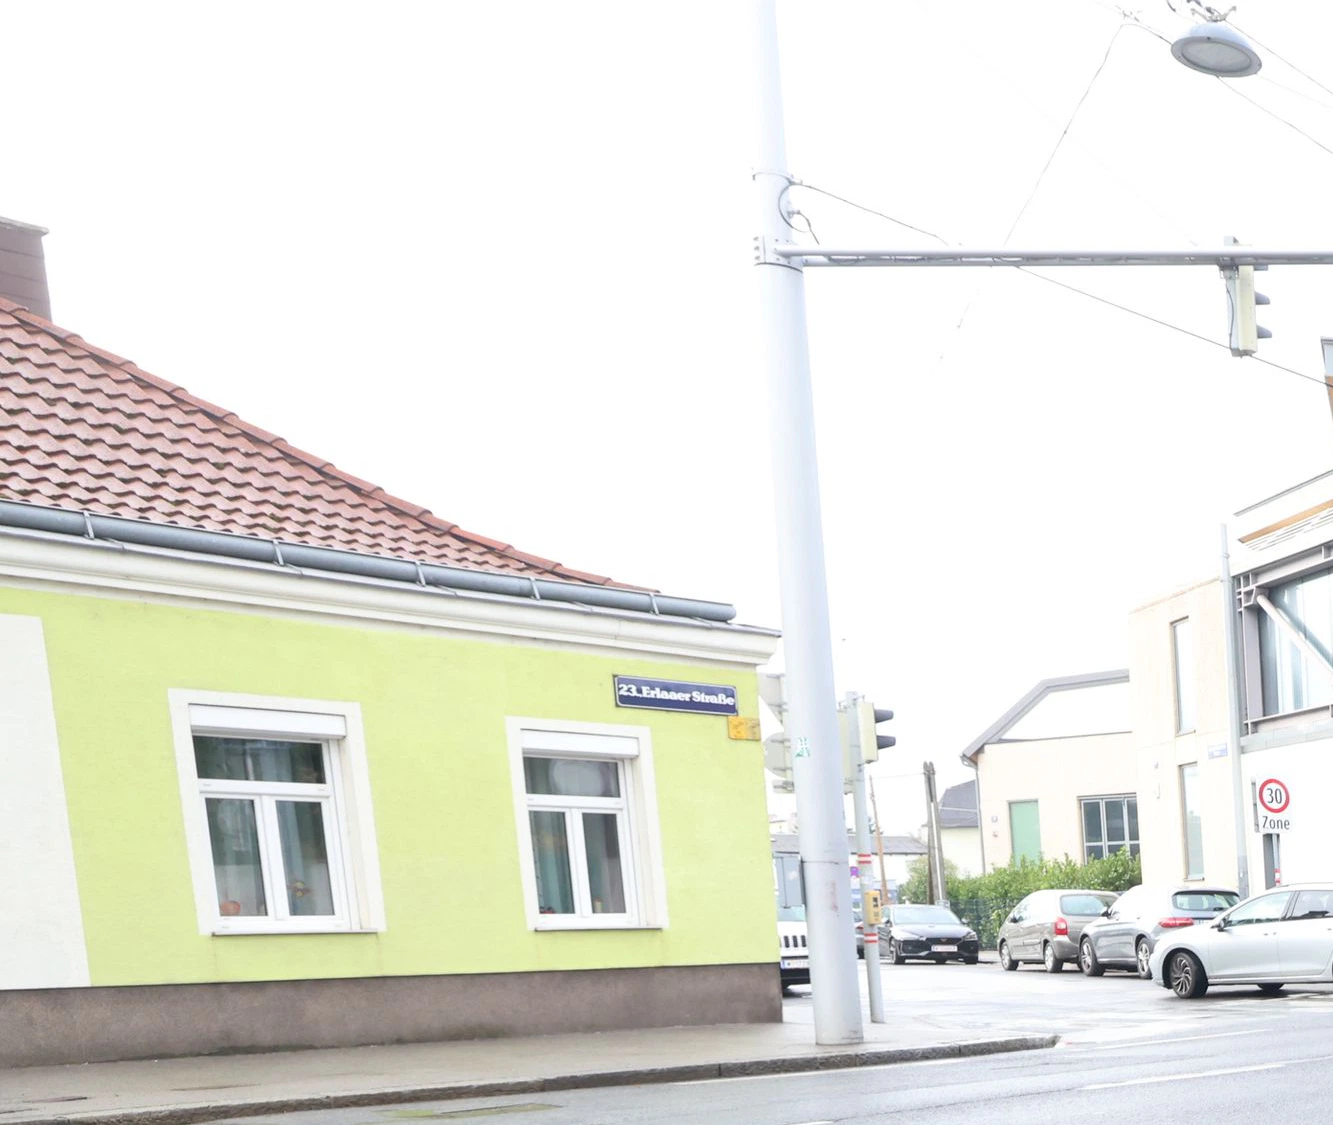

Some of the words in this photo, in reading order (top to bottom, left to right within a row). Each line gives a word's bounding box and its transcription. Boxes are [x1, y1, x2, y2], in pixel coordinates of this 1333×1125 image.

[641, 686, 691, 702] Erlaaer
[691, 690, 736, 705] Straße
[1266, 787, 1283, 804] 30
[1262, 815, 1290, 830] Zone
